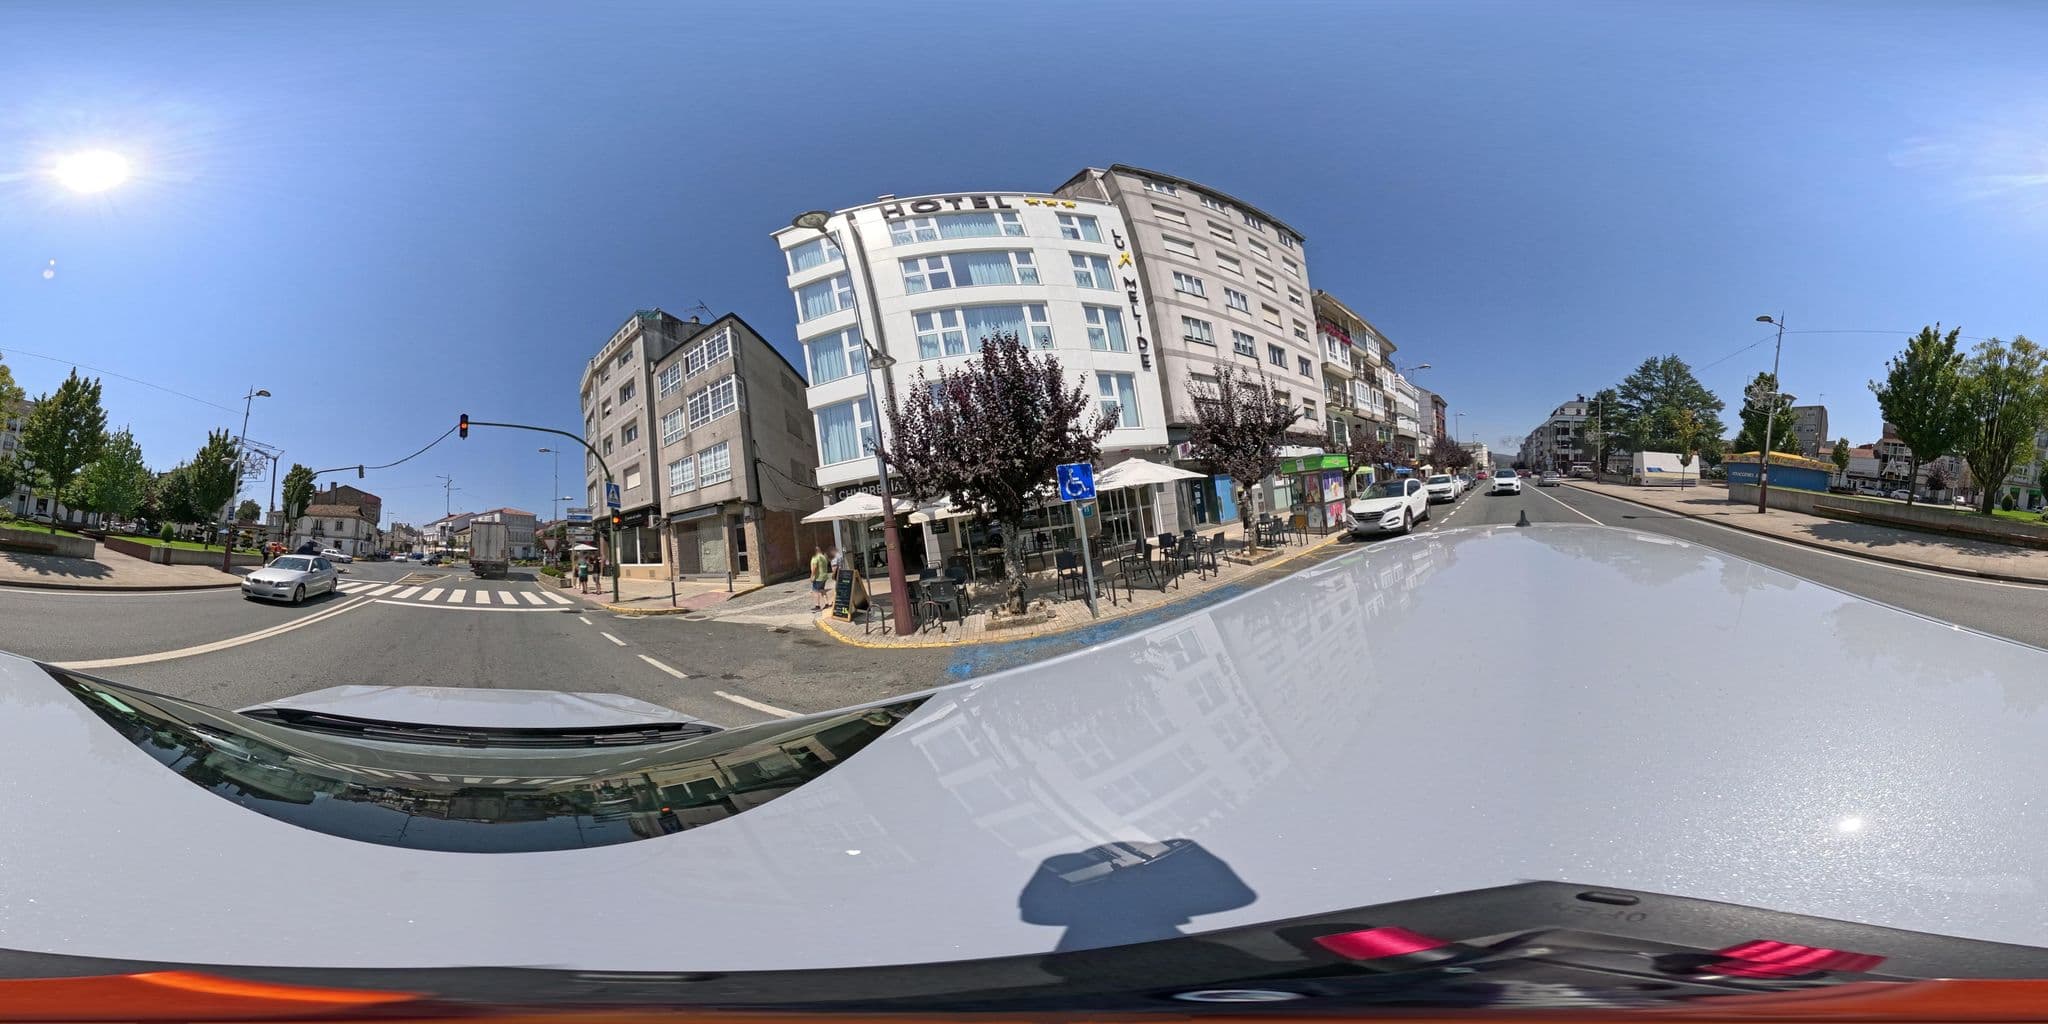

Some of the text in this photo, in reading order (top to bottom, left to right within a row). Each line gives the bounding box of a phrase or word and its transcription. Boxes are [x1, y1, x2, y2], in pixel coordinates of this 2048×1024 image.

[880, 195, 1012, 219] HOTEL
[1122, 276, 1151, 371] MELIDE
[838, 479, 903, 500] CHURREIA
